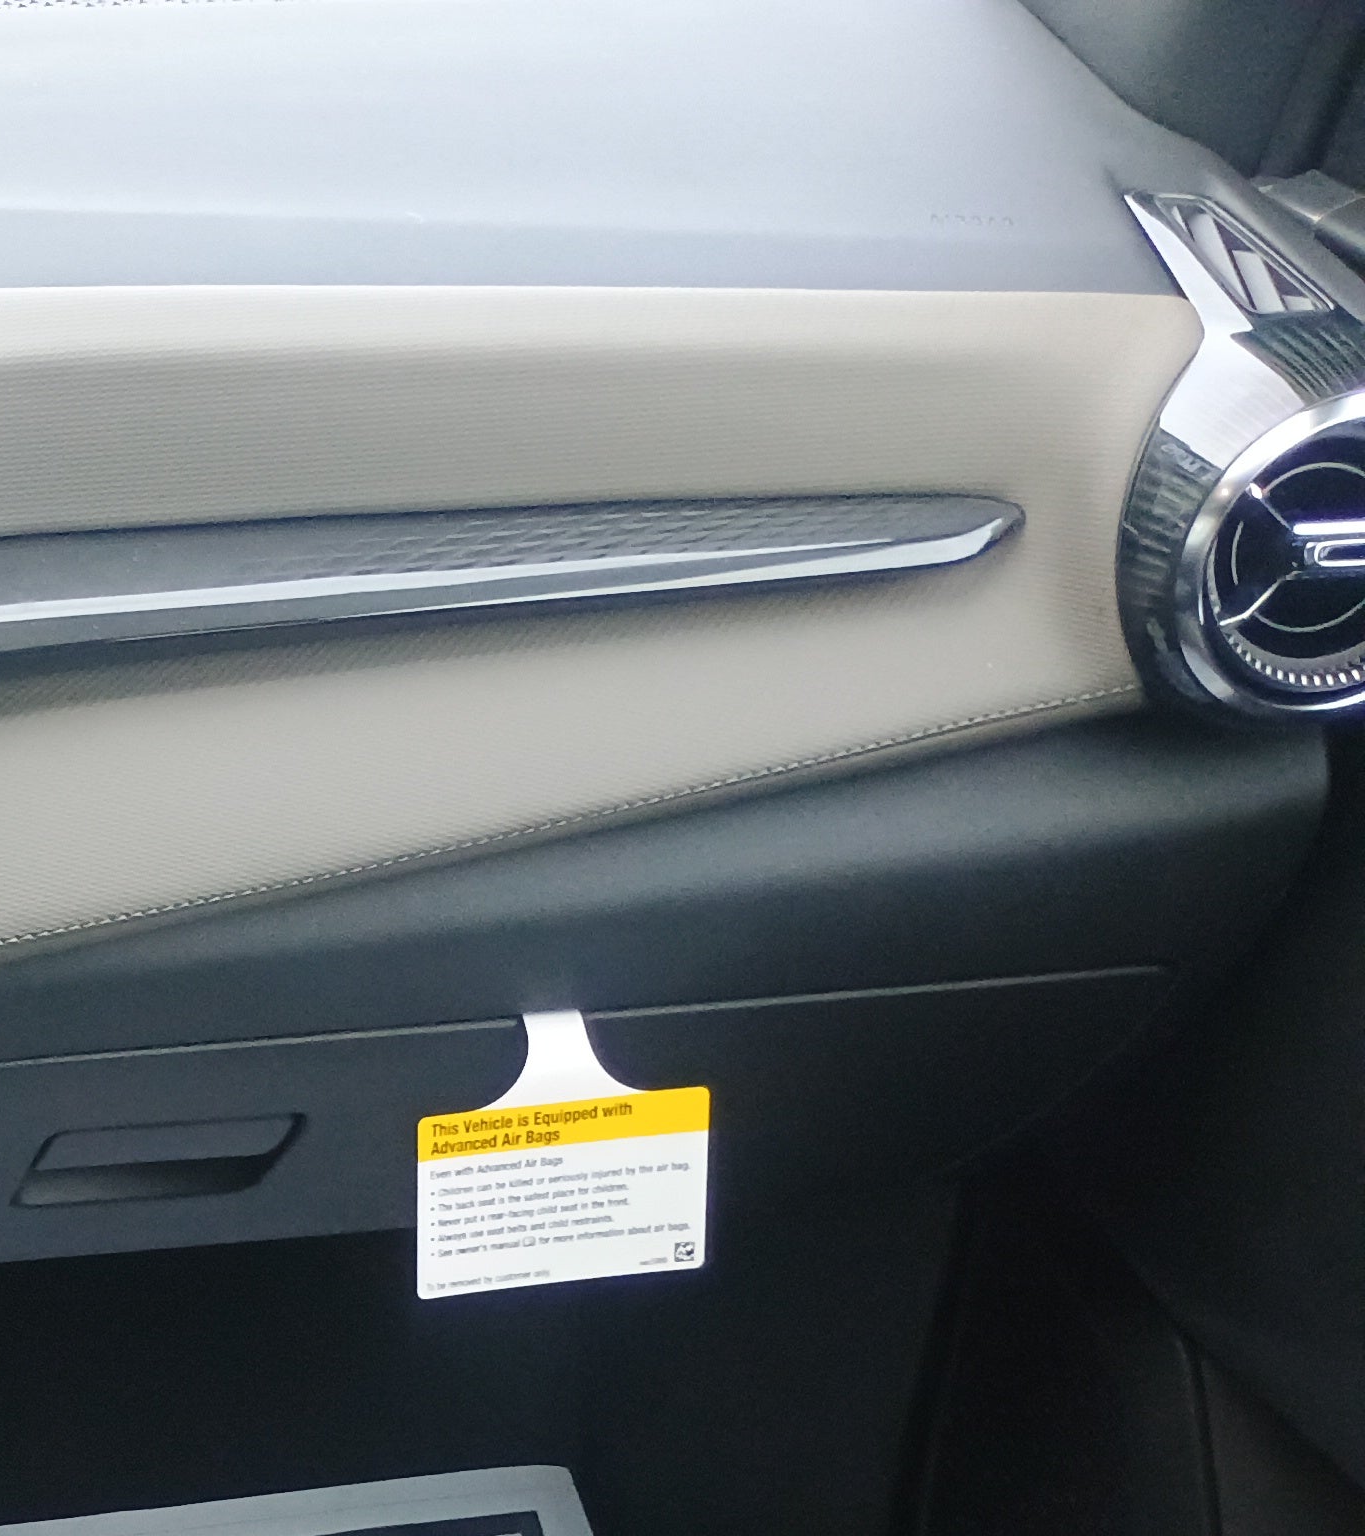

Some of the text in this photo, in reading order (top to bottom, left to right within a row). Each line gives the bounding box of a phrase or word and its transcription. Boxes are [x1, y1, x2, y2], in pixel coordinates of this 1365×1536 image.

[432, 1103, 632, 1137] This Vehicle is Equipped with
[431, 1129, 560, 1156] Advanced Air Bags
